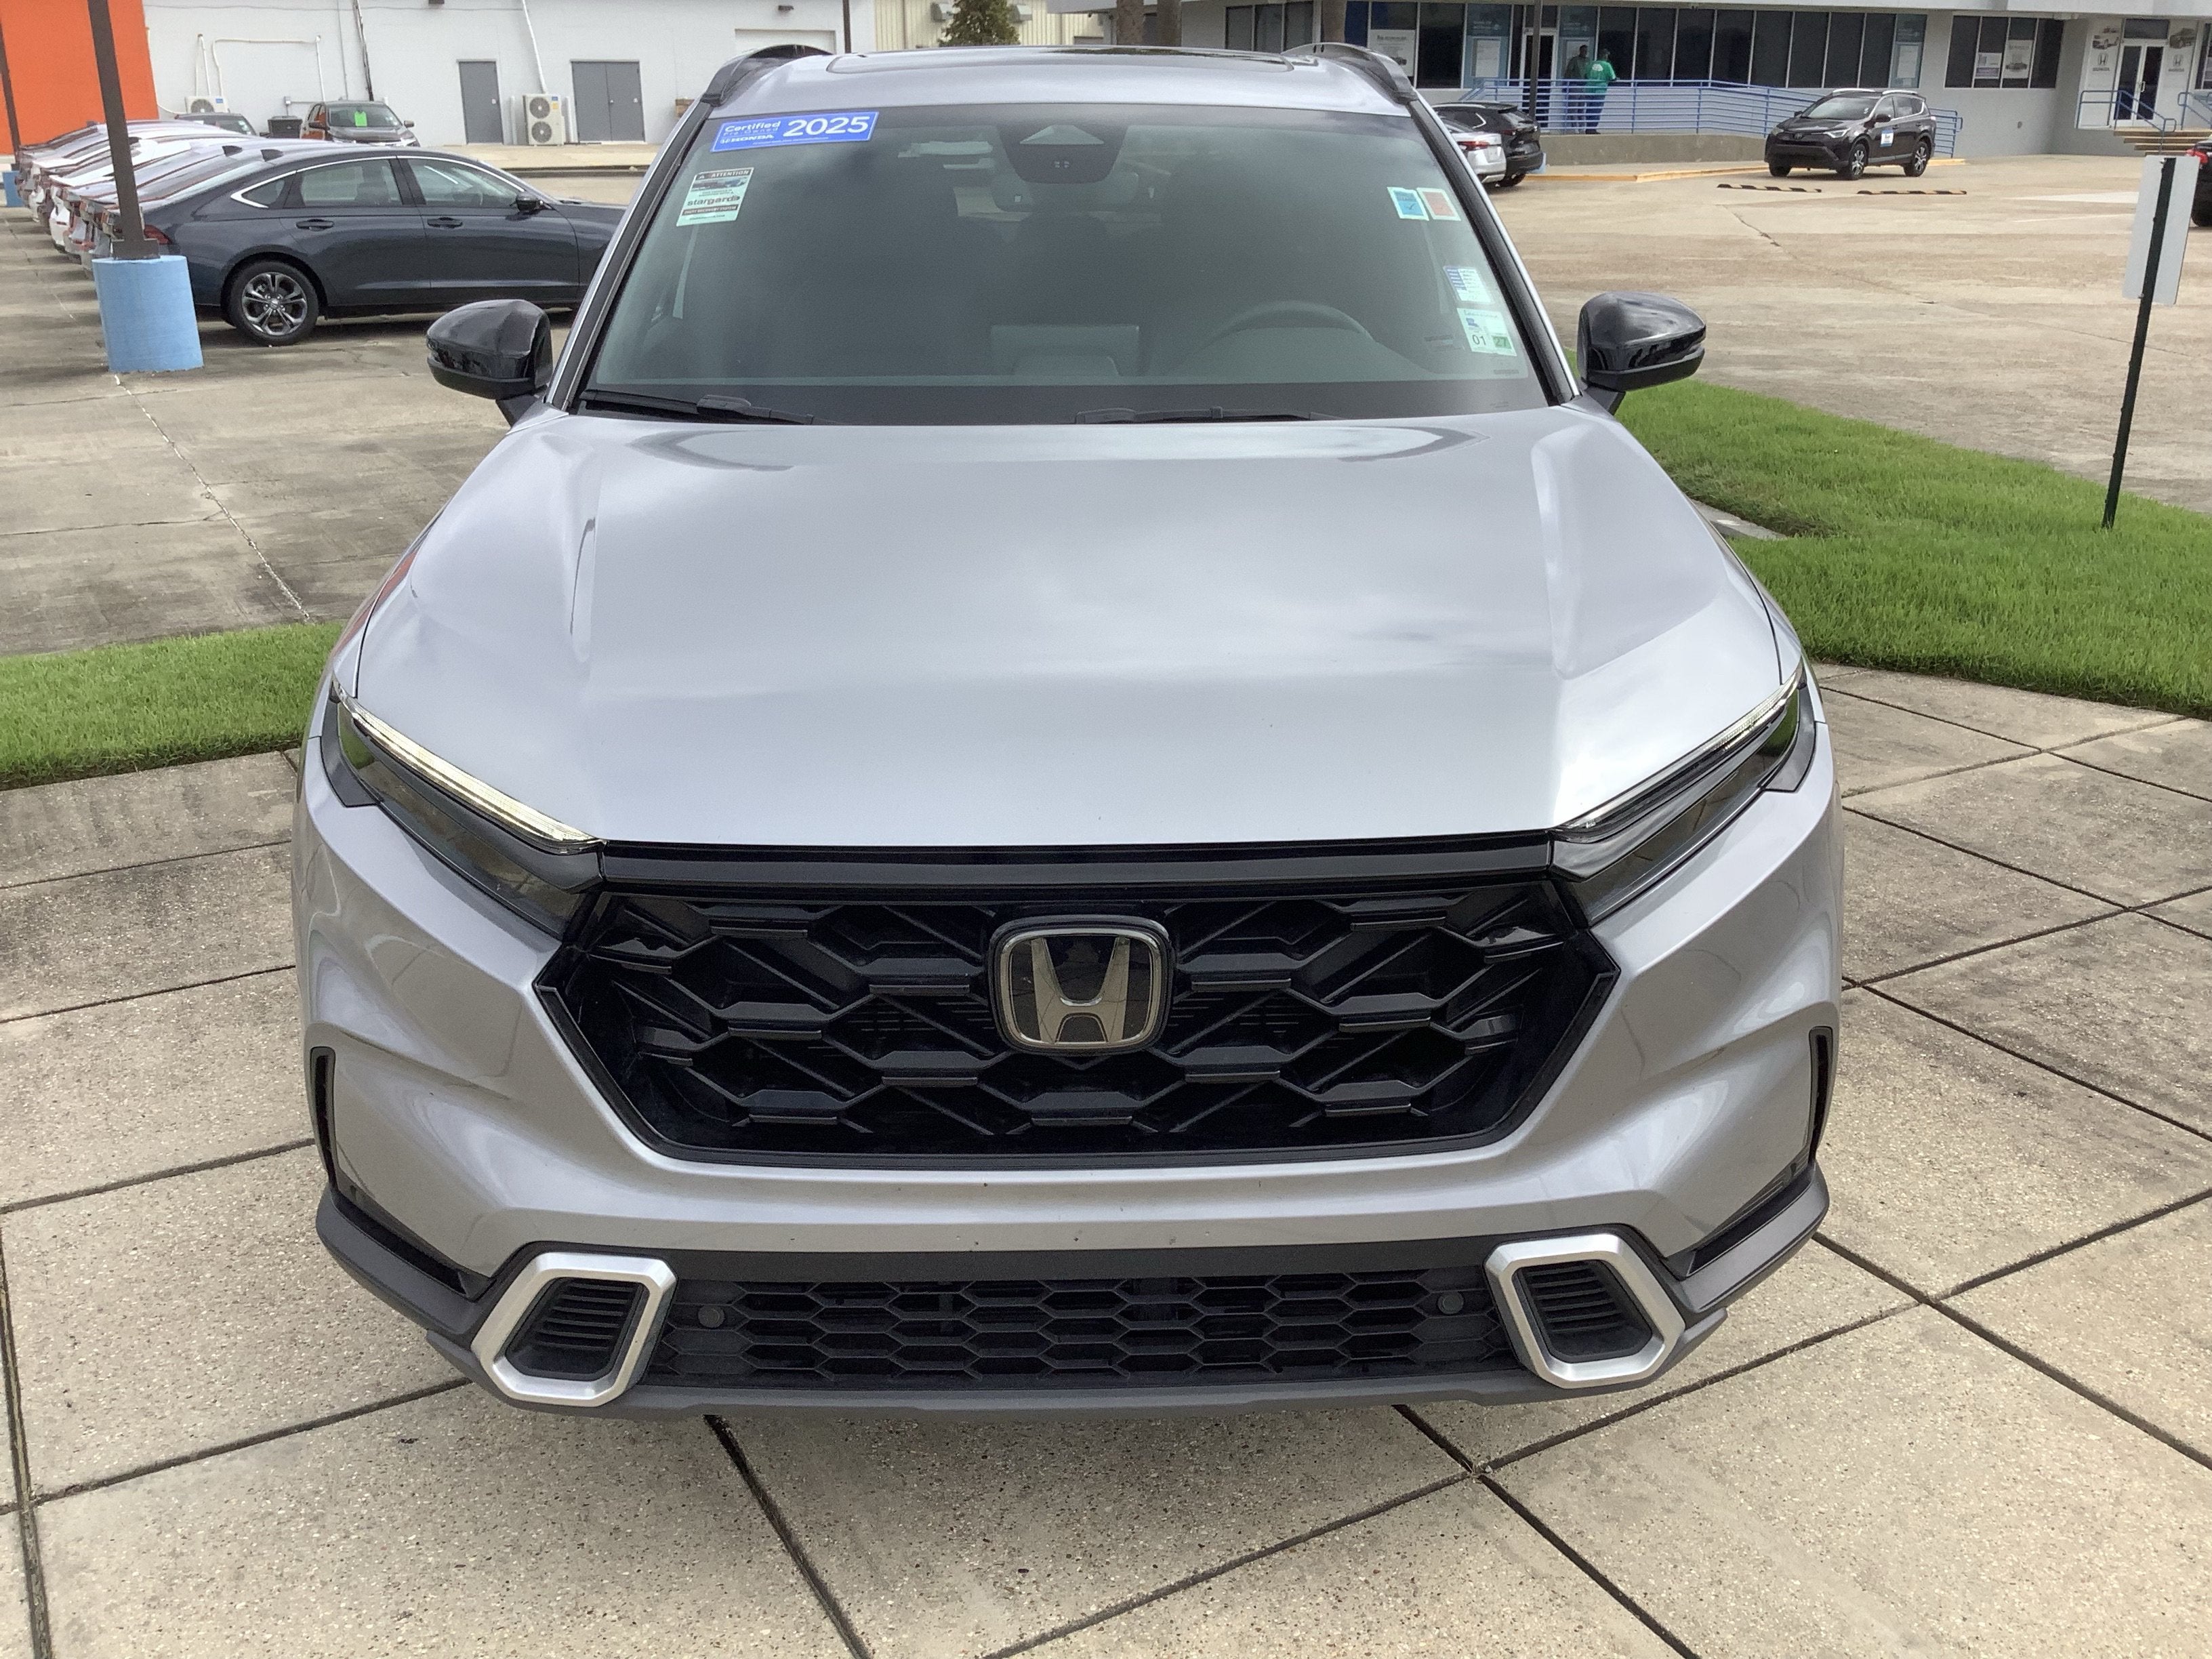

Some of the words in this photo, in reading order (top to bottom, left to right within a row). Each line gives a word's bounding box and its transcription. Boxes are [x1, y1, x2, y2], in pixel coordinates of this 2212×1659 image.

[724, 121, 781, 133] Certified
[783, 116, 870, 137] 2025
[729, 134, 775, 143] HONDA
[1472, 334, 1486, 345] 01
[1496, 337, 1507, 347] 27
